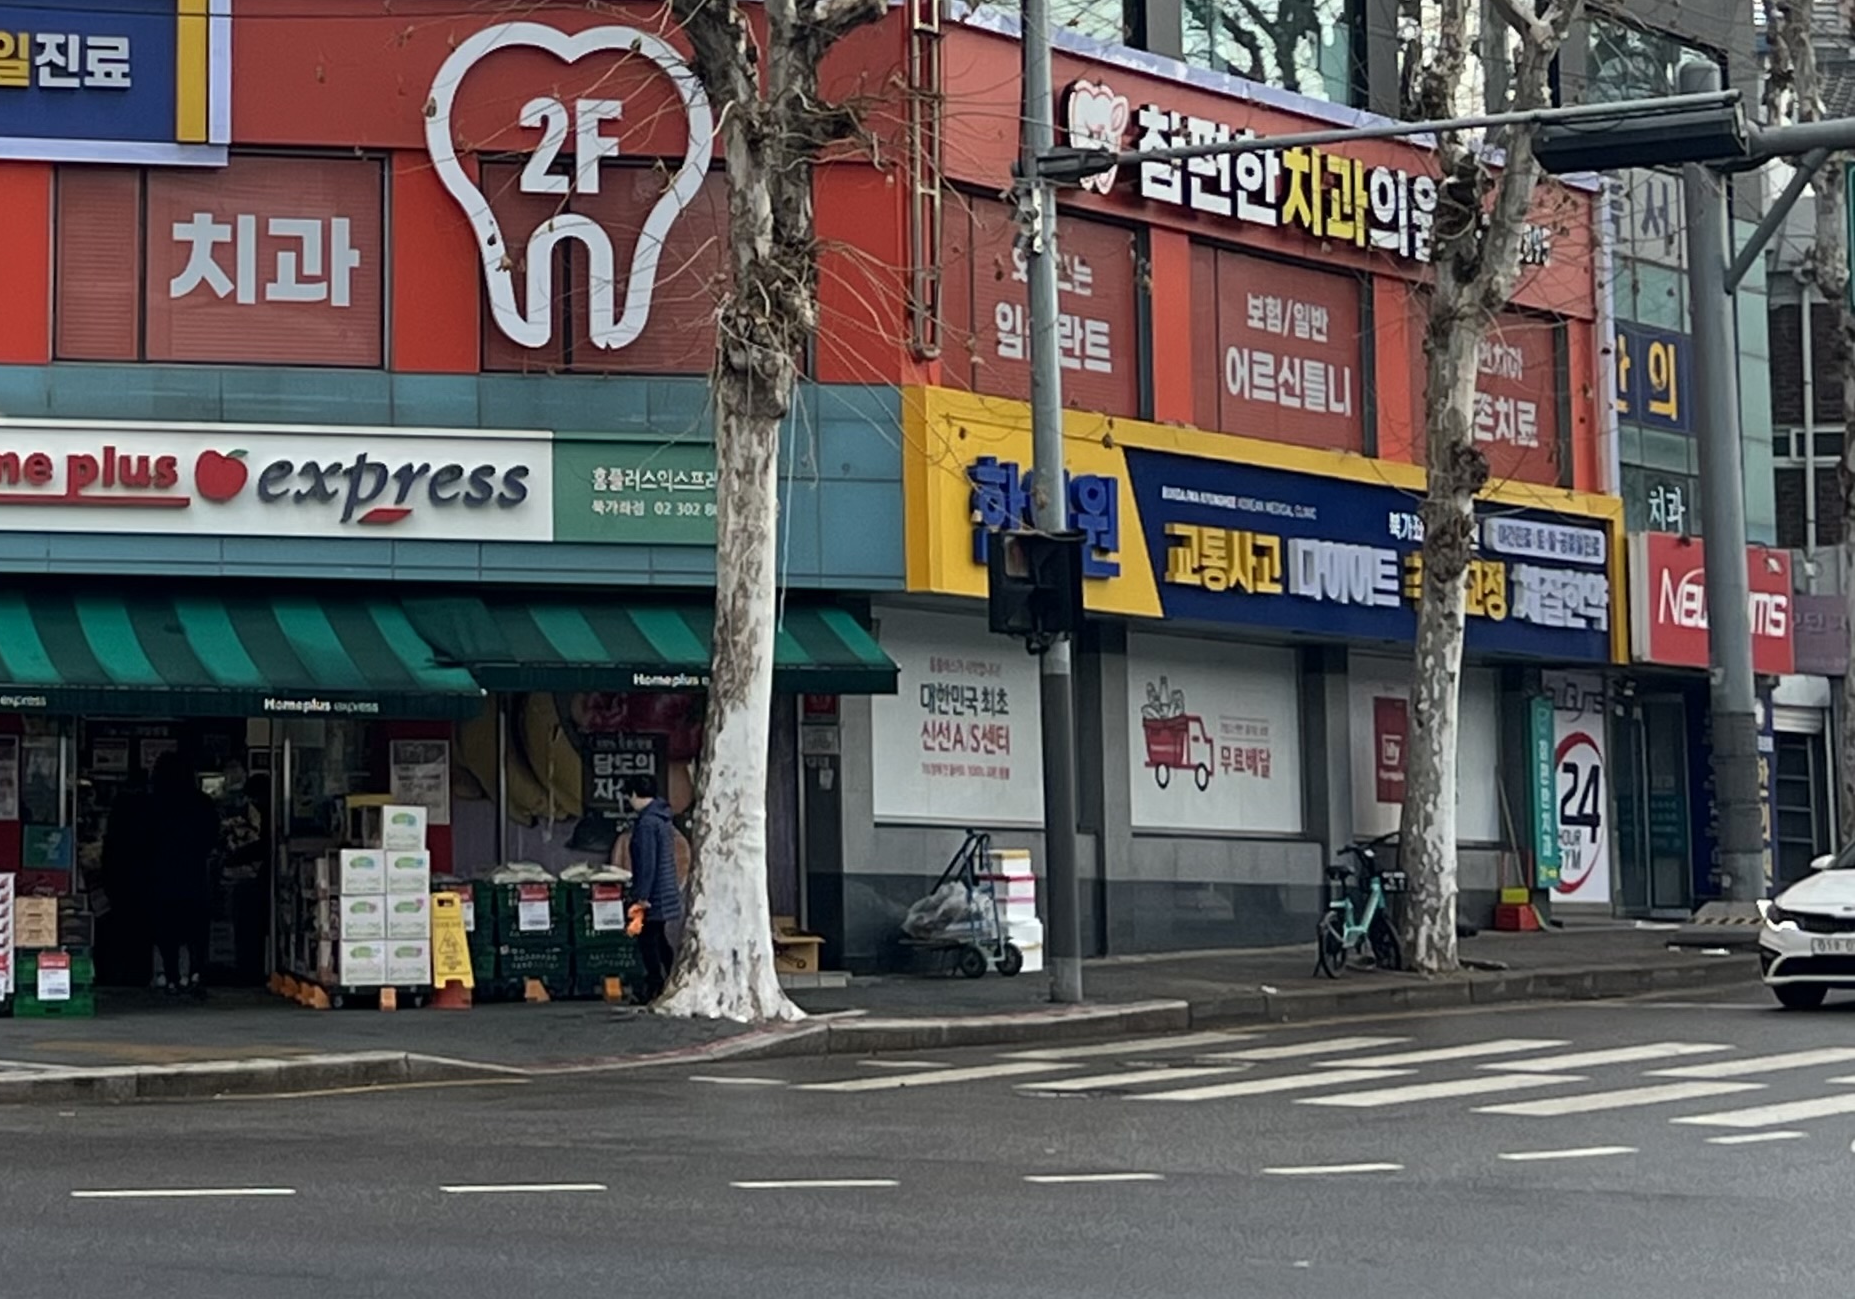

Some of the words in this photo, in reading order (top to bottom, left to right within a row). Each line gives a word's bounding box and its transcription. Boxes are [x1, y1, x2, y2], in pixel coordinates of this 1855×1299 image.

[519, 97, 623, 195] 2F
[169, 213, 360, 308] 치과
[995, 302, 1113, 374] 임란트
[1247, 292, 1330, 343] 보험/일반
[1226, 346, 1352, 418] 어르신틀니
[66, 445, 178, 497] plus
[257, 452, 530, 524] express
[592, 467, 717, 493] 홈플러스익스프레
[654, 501, 672, 516] 02
[676, 502, 700, 517] 302
[1649, 486, 1686, 533] 치과
[967, 455, 1121, 580] 한원
[1163, 522, 1284, 596] 교통사고
[1658, 568, 1788, 638] Nems
[263, 697, 331, 714] Homeplus
[920, 683, 979, 717] 대한민국
[980, 686, 1010, 717] 최초
[1220, 745, 1272, 780] 무료배달
[1560, 762, 1601, 844] 24
